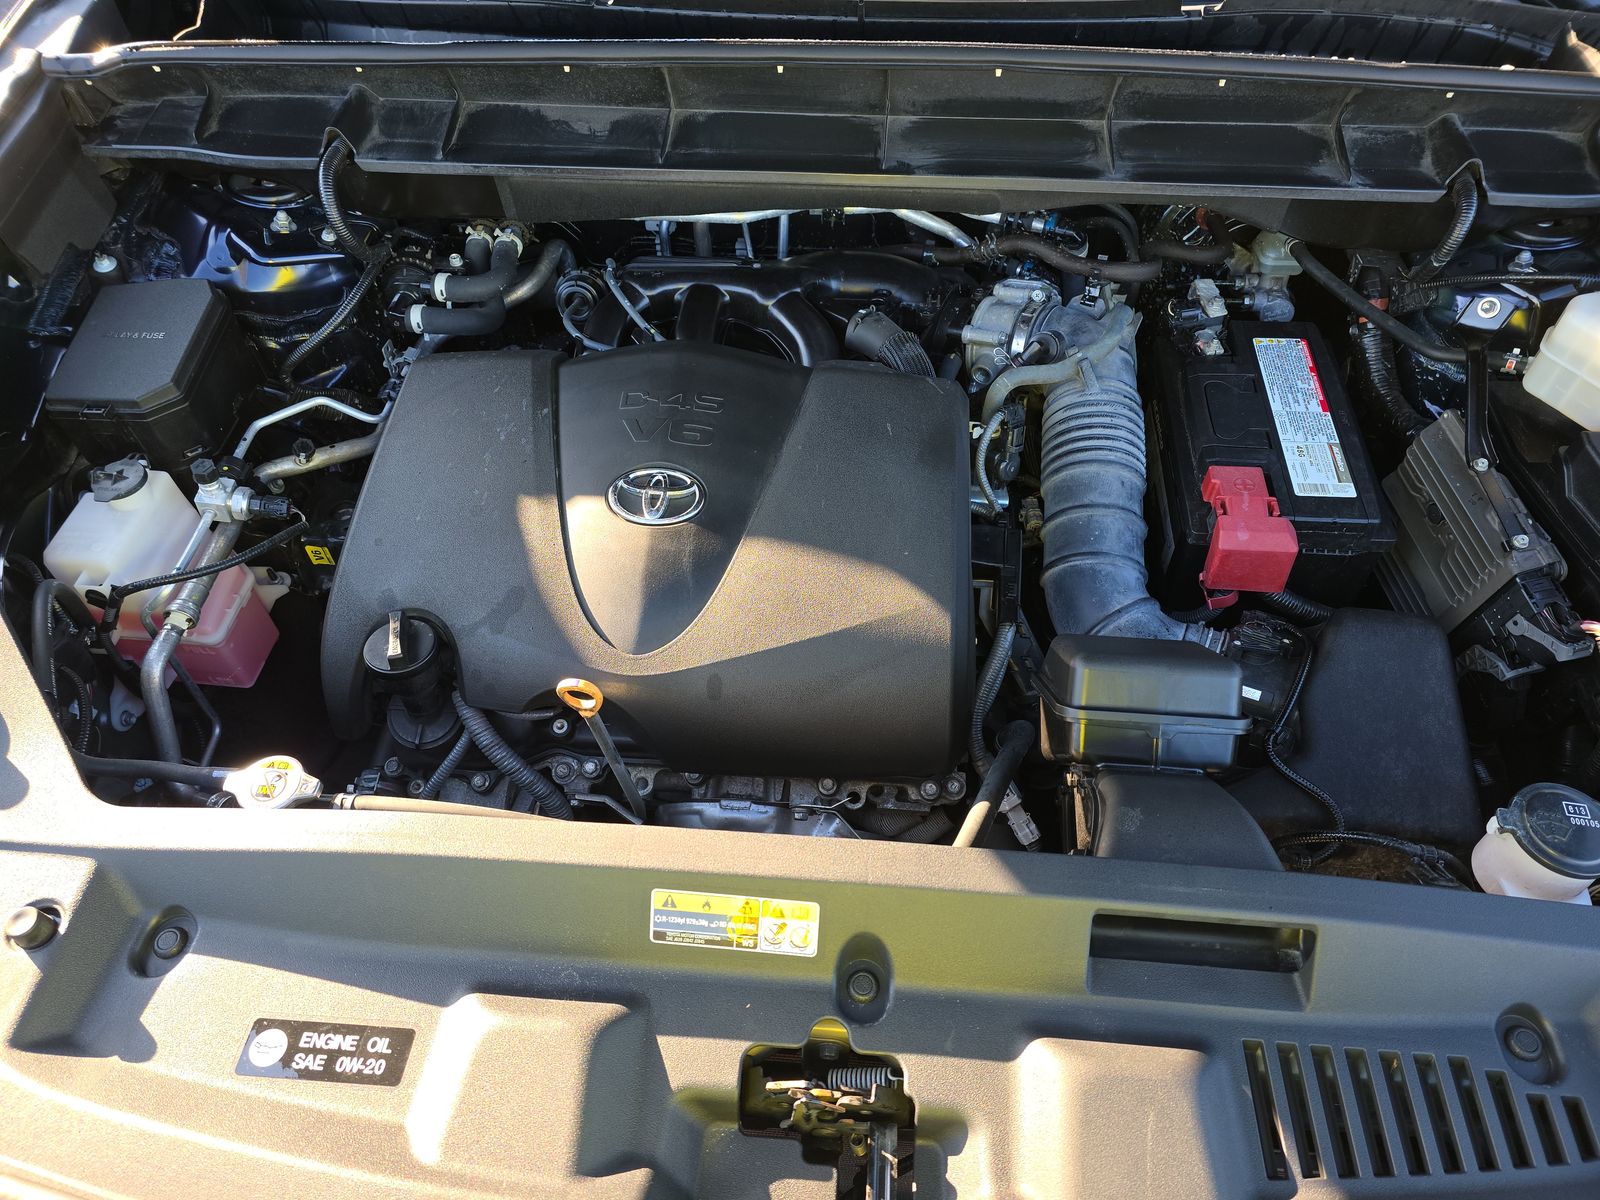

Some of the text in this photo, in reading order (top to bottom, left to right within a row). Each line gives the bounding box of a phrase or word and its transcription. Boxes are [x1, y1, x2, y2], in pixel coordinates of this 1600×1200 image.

[141, 331, 166, 339] FUSE
[620, 416, 715, 447] V6
[1570, 816, 1600, 828] 000105
[299, 1031, 392, 1054] ENGINE OIL
[291, 1053, 387, 1076] SAE 0W-20
